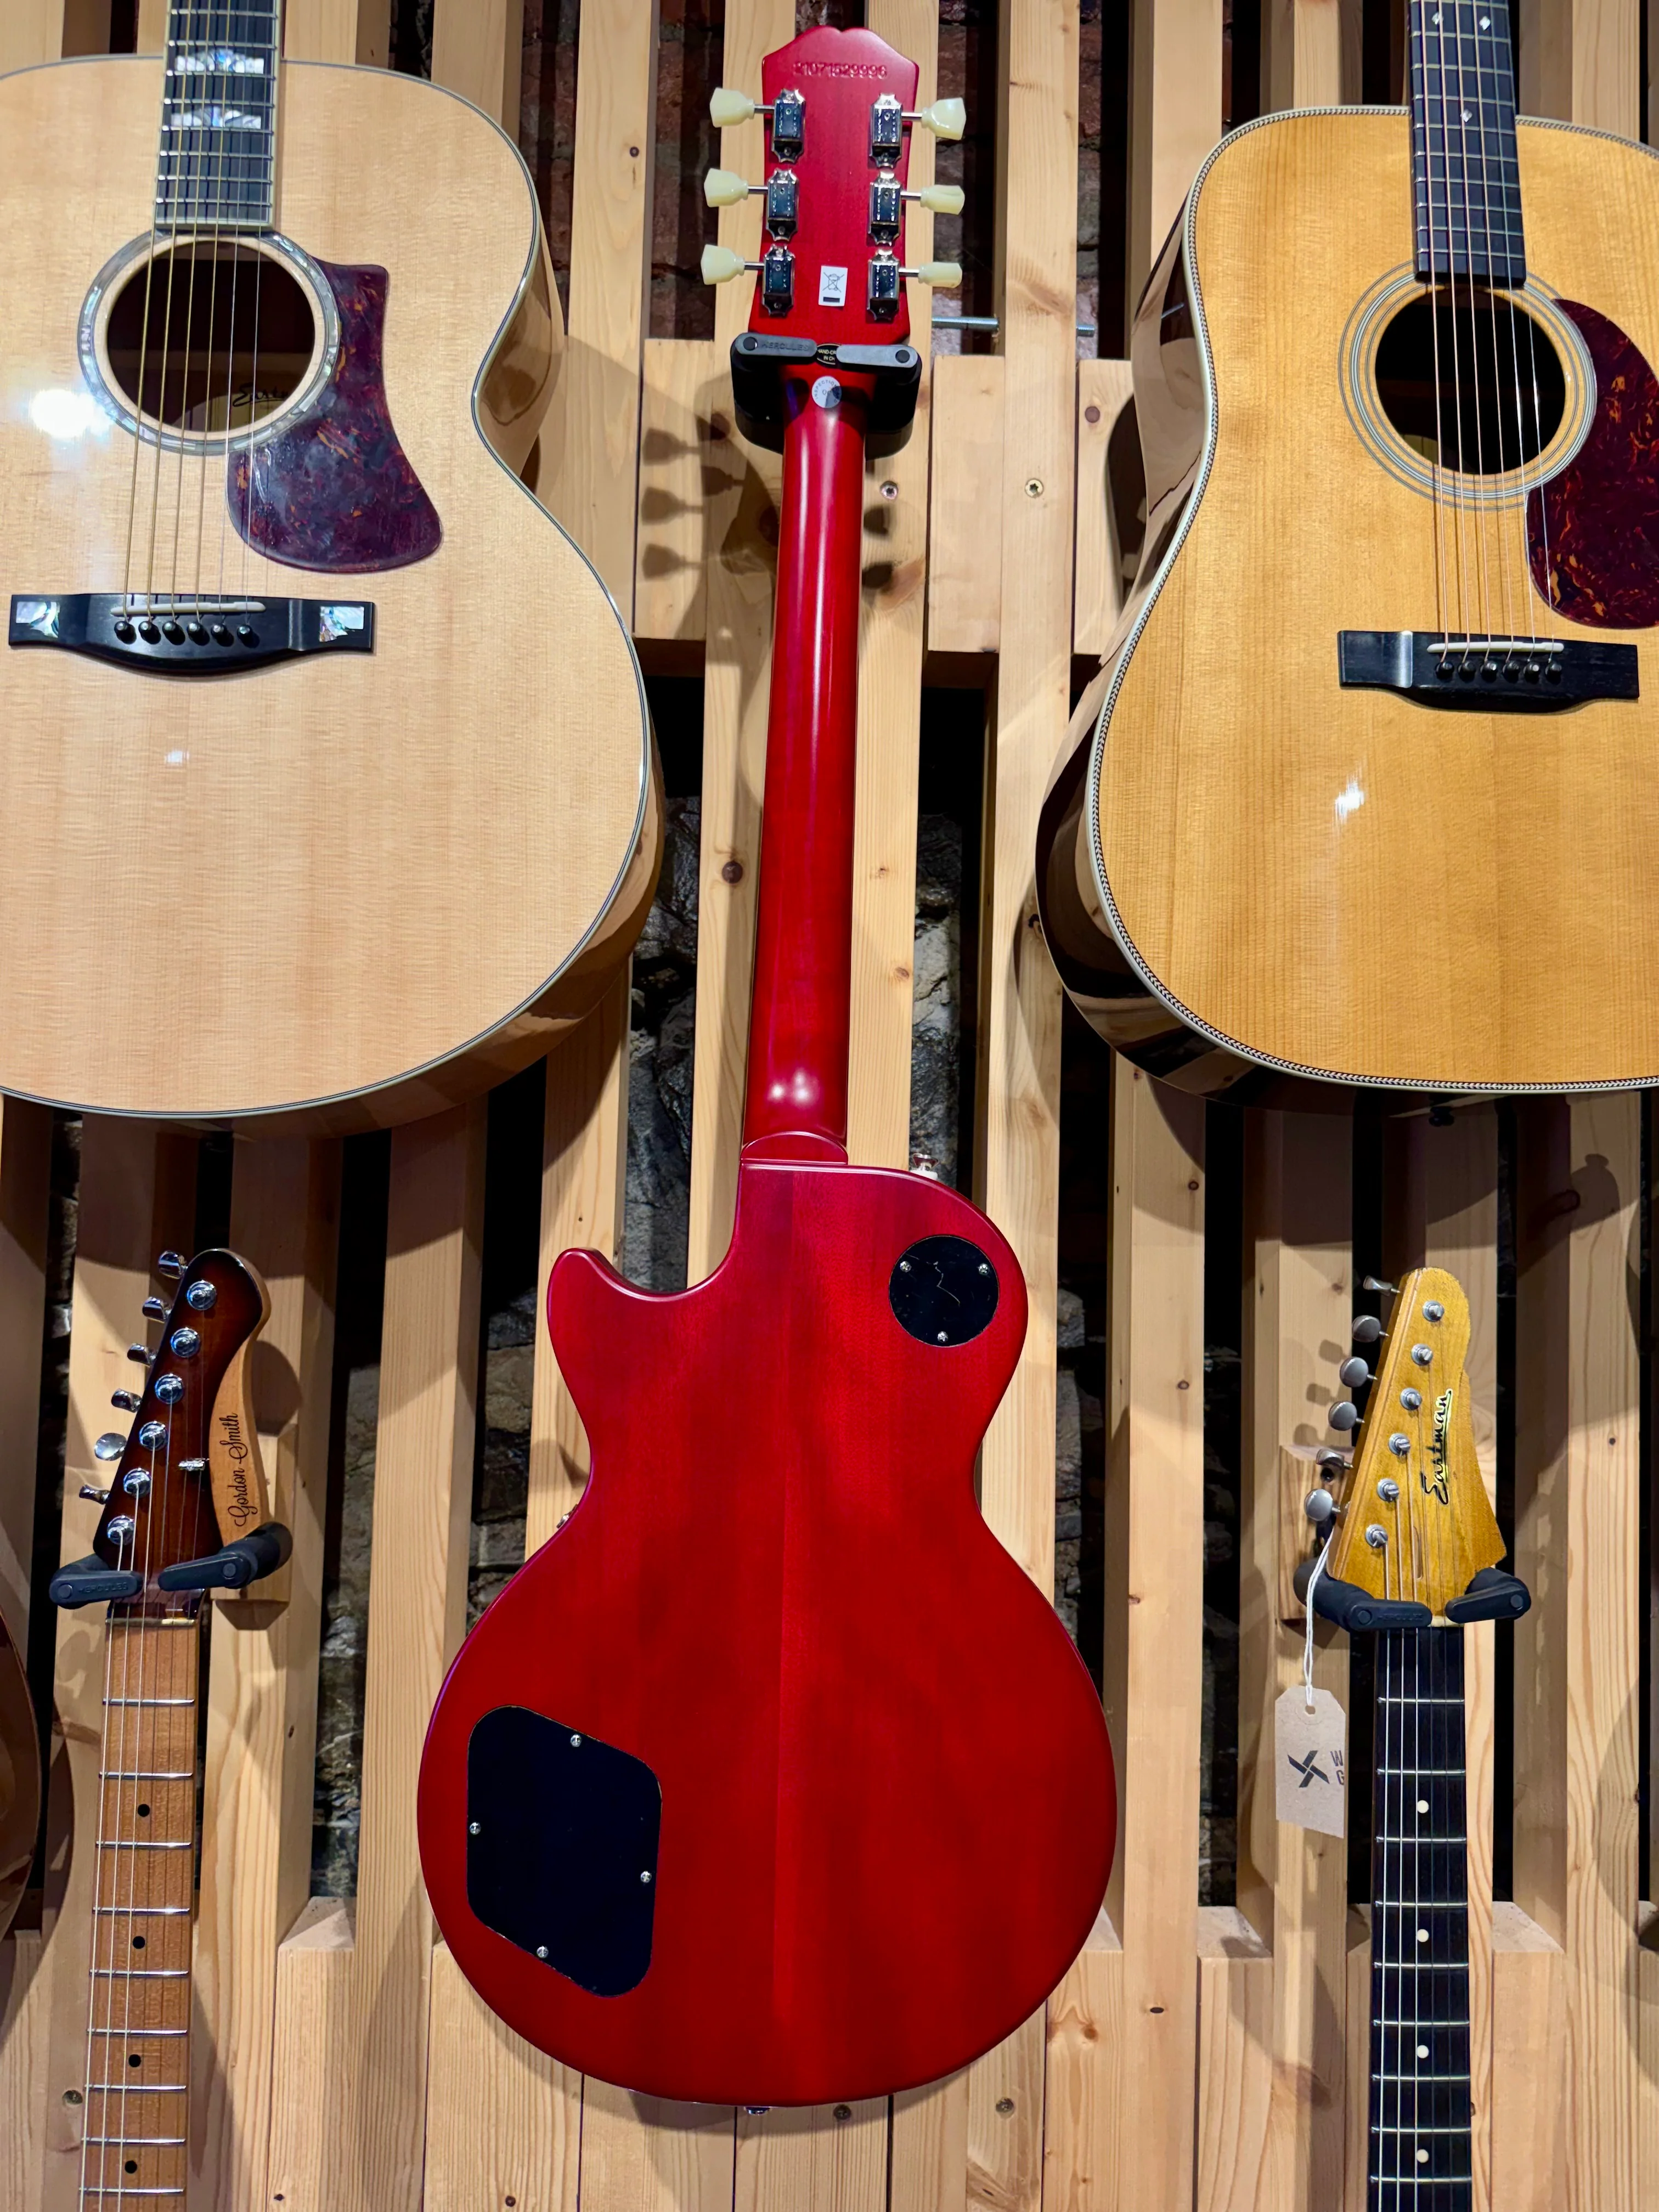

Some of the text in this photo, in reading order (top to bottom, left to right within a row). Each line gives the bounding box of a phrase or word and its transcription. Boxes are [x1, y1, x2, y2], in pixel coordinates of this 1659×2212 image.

[761, 341, 809, 351] HERCULES
[219, 1413, 258, 1527] Gordon Smith
[1420, 1389, 1453, 1505] Eastman
